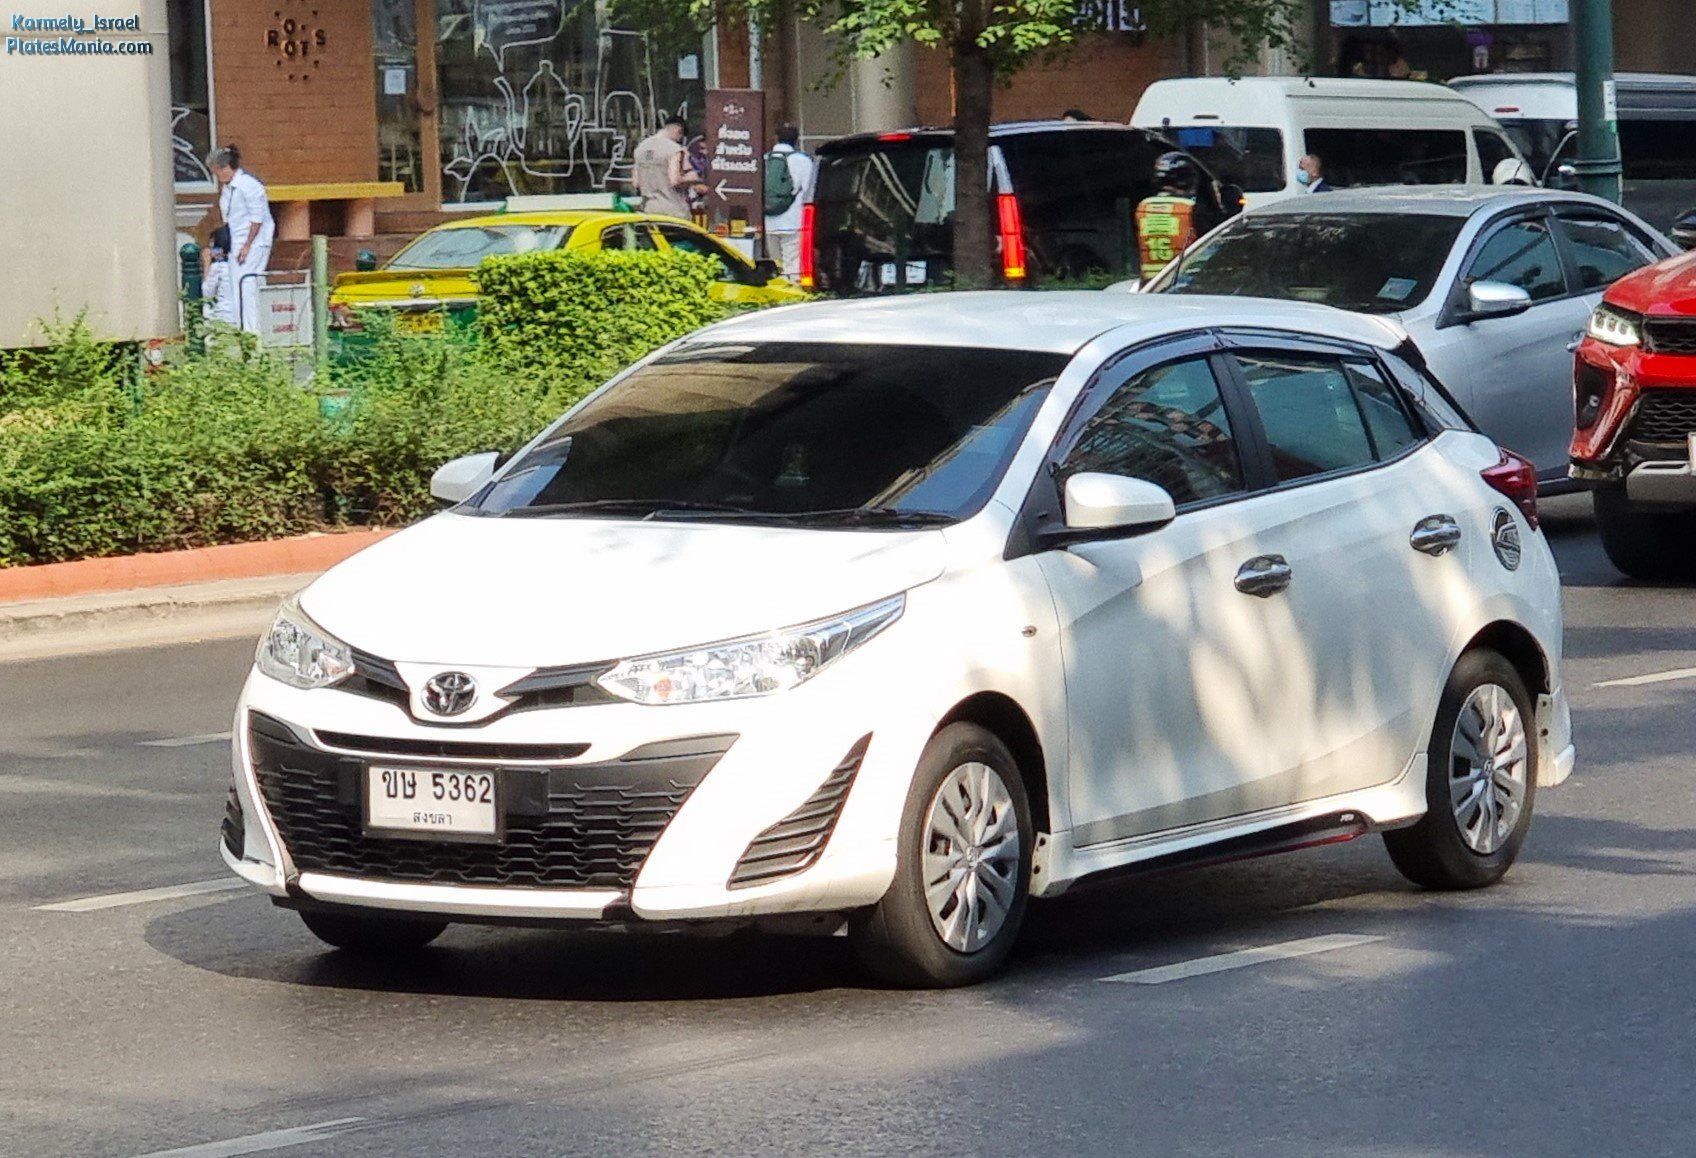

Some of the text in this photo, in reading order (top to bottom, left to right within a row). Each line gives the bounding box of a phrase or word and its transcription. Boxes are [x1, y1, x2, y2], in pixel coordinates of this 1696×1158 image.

[381, 770, 492, 804] ขษ 5362
[412, 811, 453, 826] สงขลา
